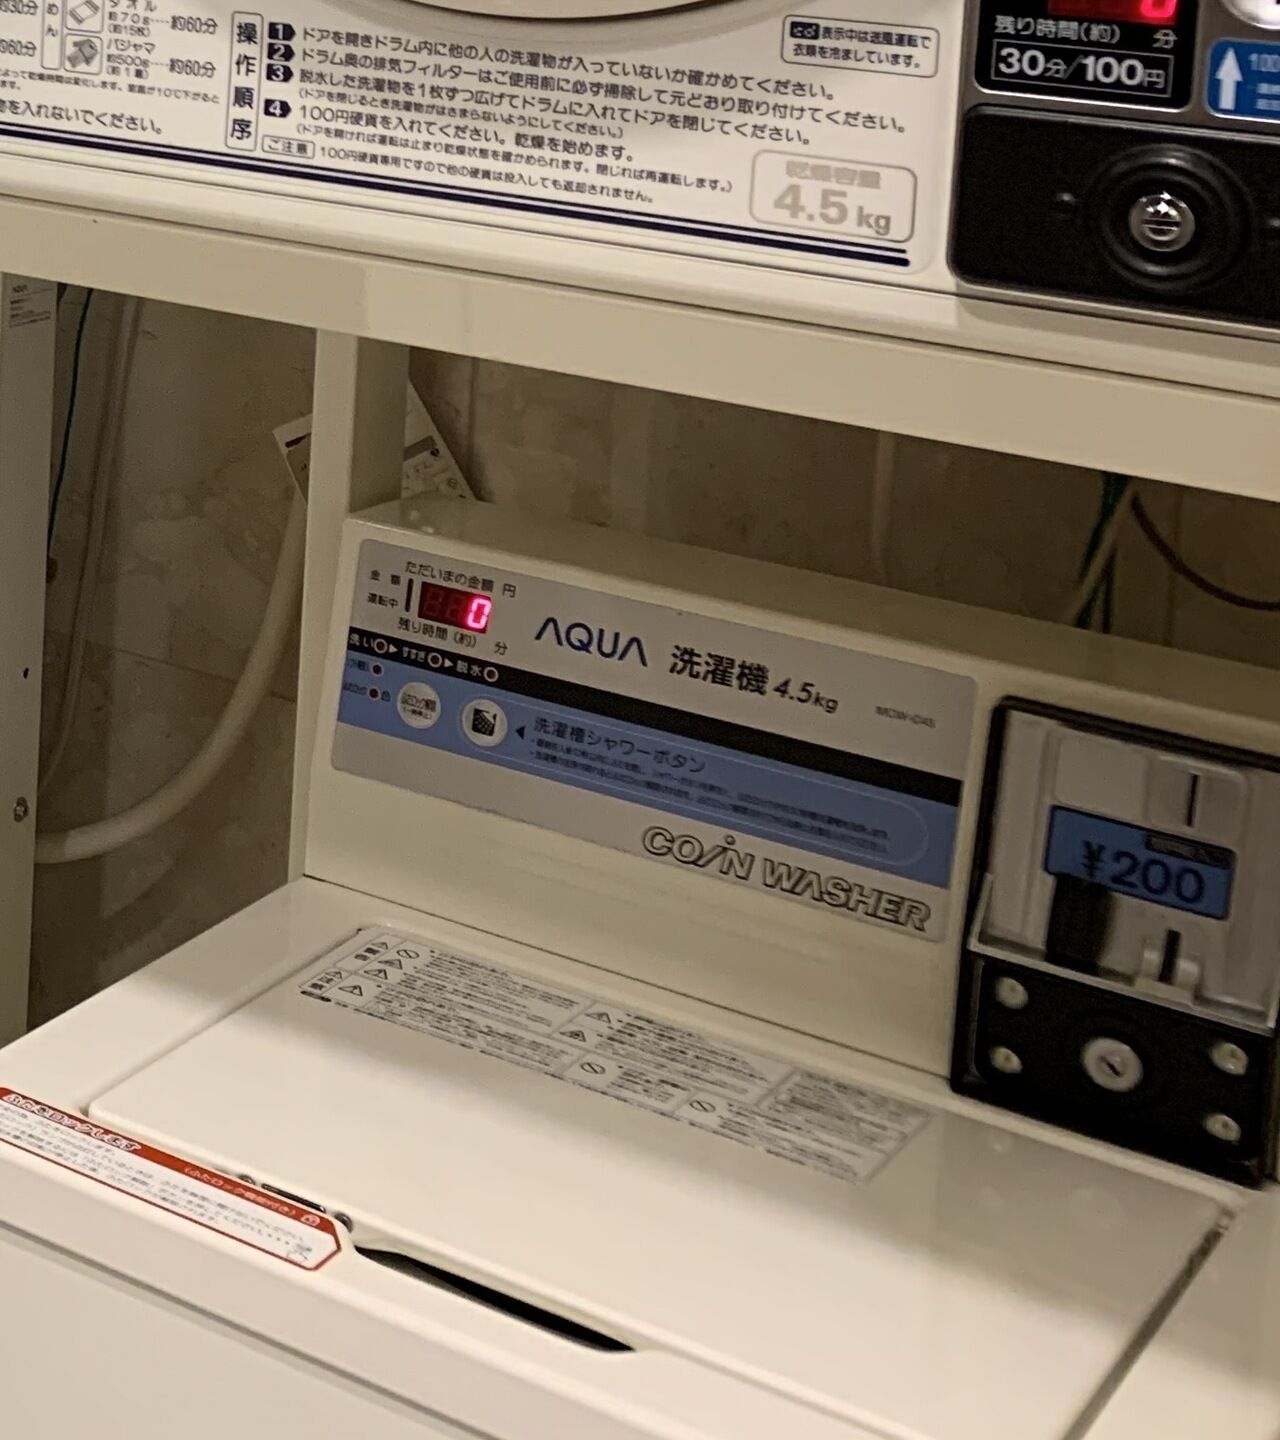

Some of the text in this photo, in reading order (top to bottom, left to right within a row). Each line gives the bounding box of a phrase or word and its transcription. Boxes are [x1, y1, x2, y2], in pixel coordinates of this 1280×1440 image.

[1152, 28, 1178, 51] 分
[229, 22, 259, 141] 操作順序
[267, 99, 283, 118] 4
[773, 183, 892, 237] 4.5 kg
[404, 561, 517, 598] ただいまの金額 円
[466, 597, 492, 630] 0
[494, 641, 508, 656] 分
[534, 616, 648, 668] AQUA
[668, 644, 769, 696] 洗濯機
[773, 678, 839, 715] 4.5kg
[533, 717, 707, 774] 洗濯槽シャワーボタン
[761, 857, 932, 934] WASHER
[1079, 839, 1206, 905] ¥200
